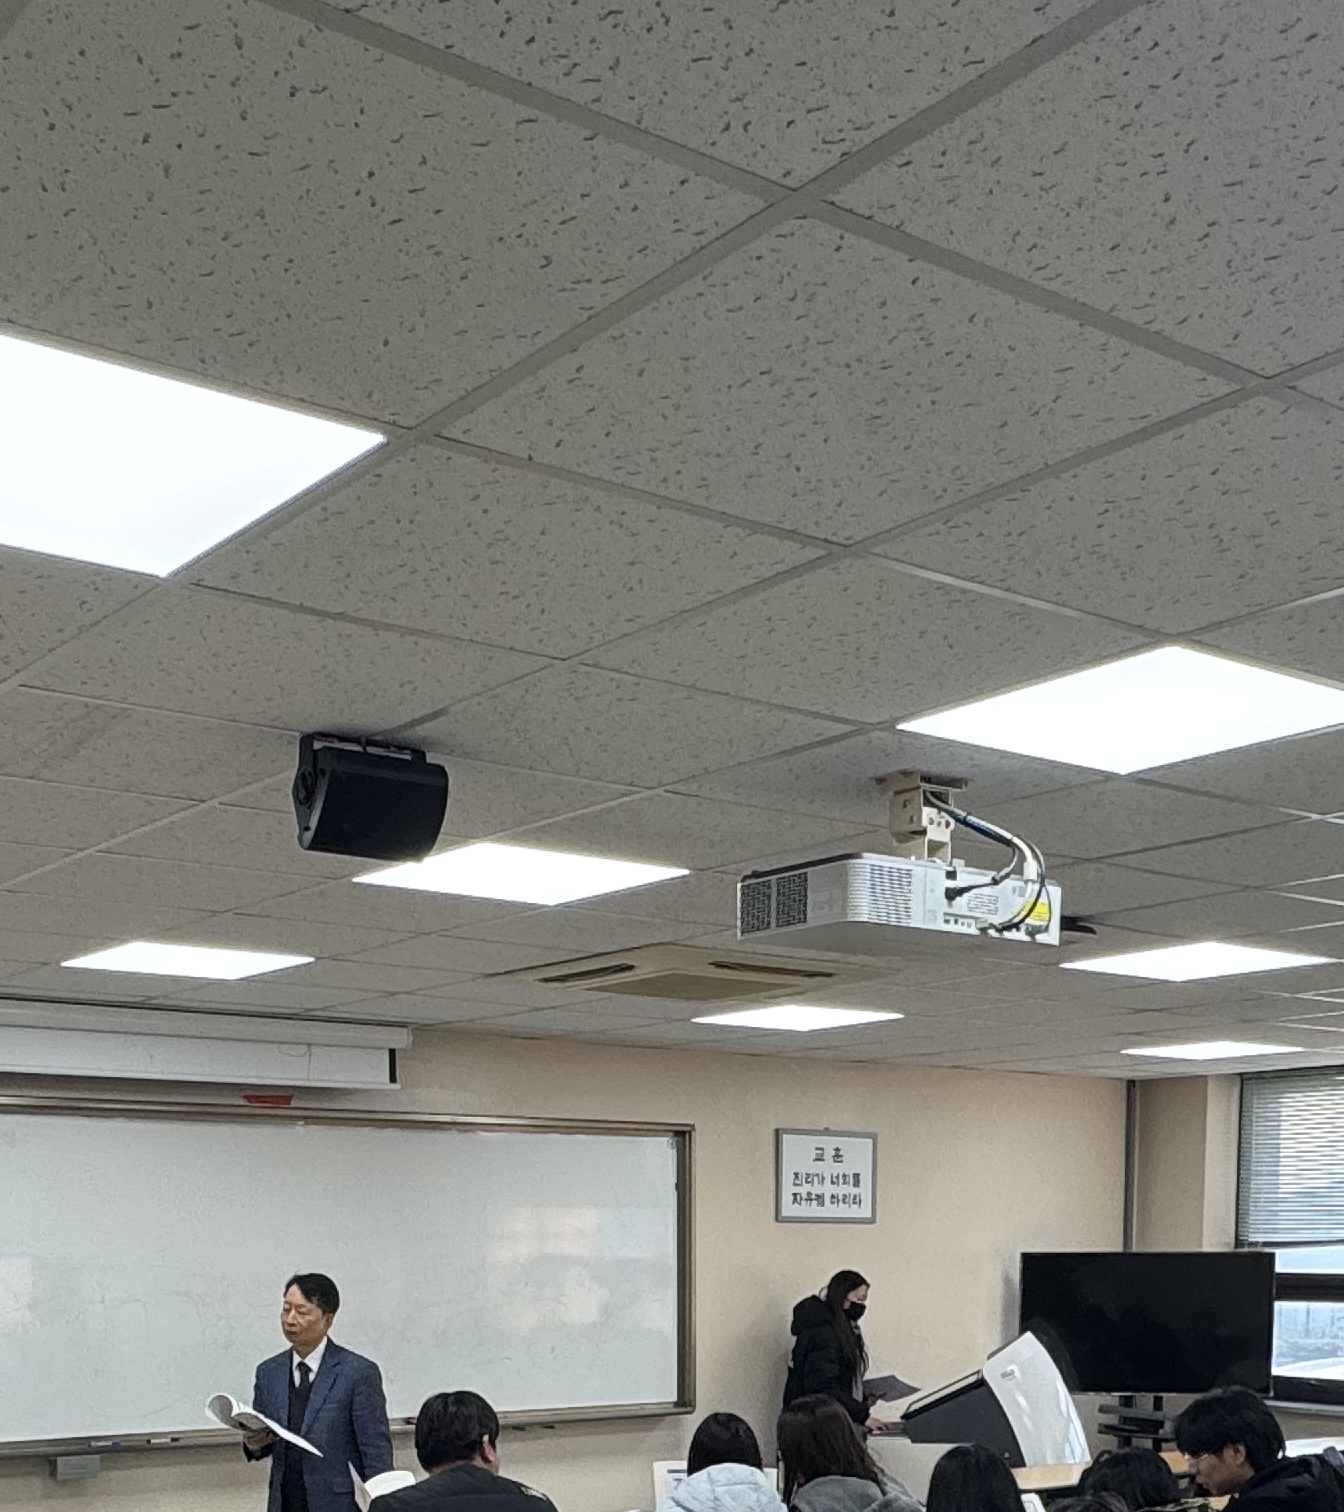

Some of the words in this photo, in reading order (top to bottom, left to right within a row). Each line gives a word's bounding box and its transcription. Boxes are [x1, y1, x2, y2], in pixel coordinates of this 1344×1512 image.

[792, 1171, 826, 1188] 진리가
[830, 1172, 861, 1188] 너희를
[830, 1192, 862, 1210] 하리라
